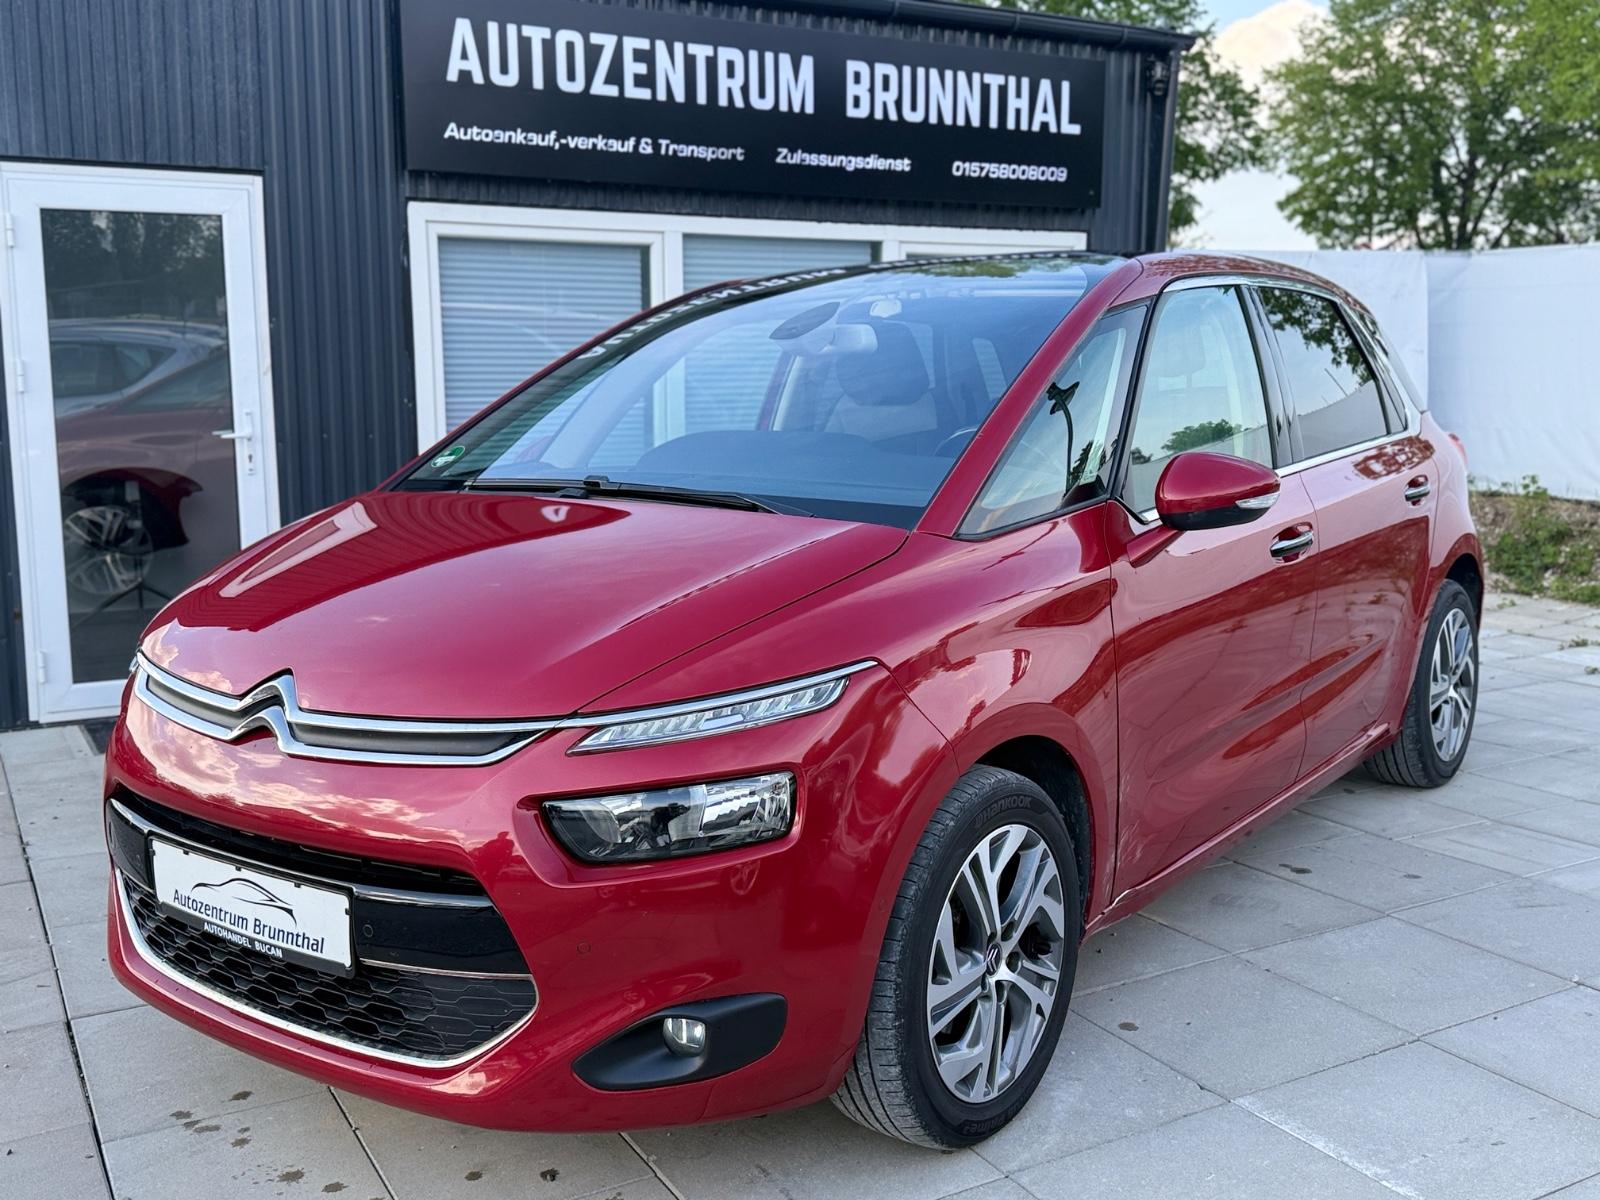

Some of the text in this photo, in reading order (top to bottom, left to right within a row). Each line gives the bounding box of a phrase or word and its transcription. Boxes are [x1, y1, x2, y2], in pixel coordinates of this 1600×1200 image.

[446, 17, 1081, 136] AUTOZENTRUM BRUNNTHAL
[638, 138, 653, 154] &
[658, 139, 745, 162] Transport
[776, 148, 911, 172] Zulassungsdienst
[952, 160, 1068, 182] 015758008009
[173, 889, 325, 954] Autozentrum Brunnthal
[204, 922, 283, 959] AUTOHANDEL BUCAN
